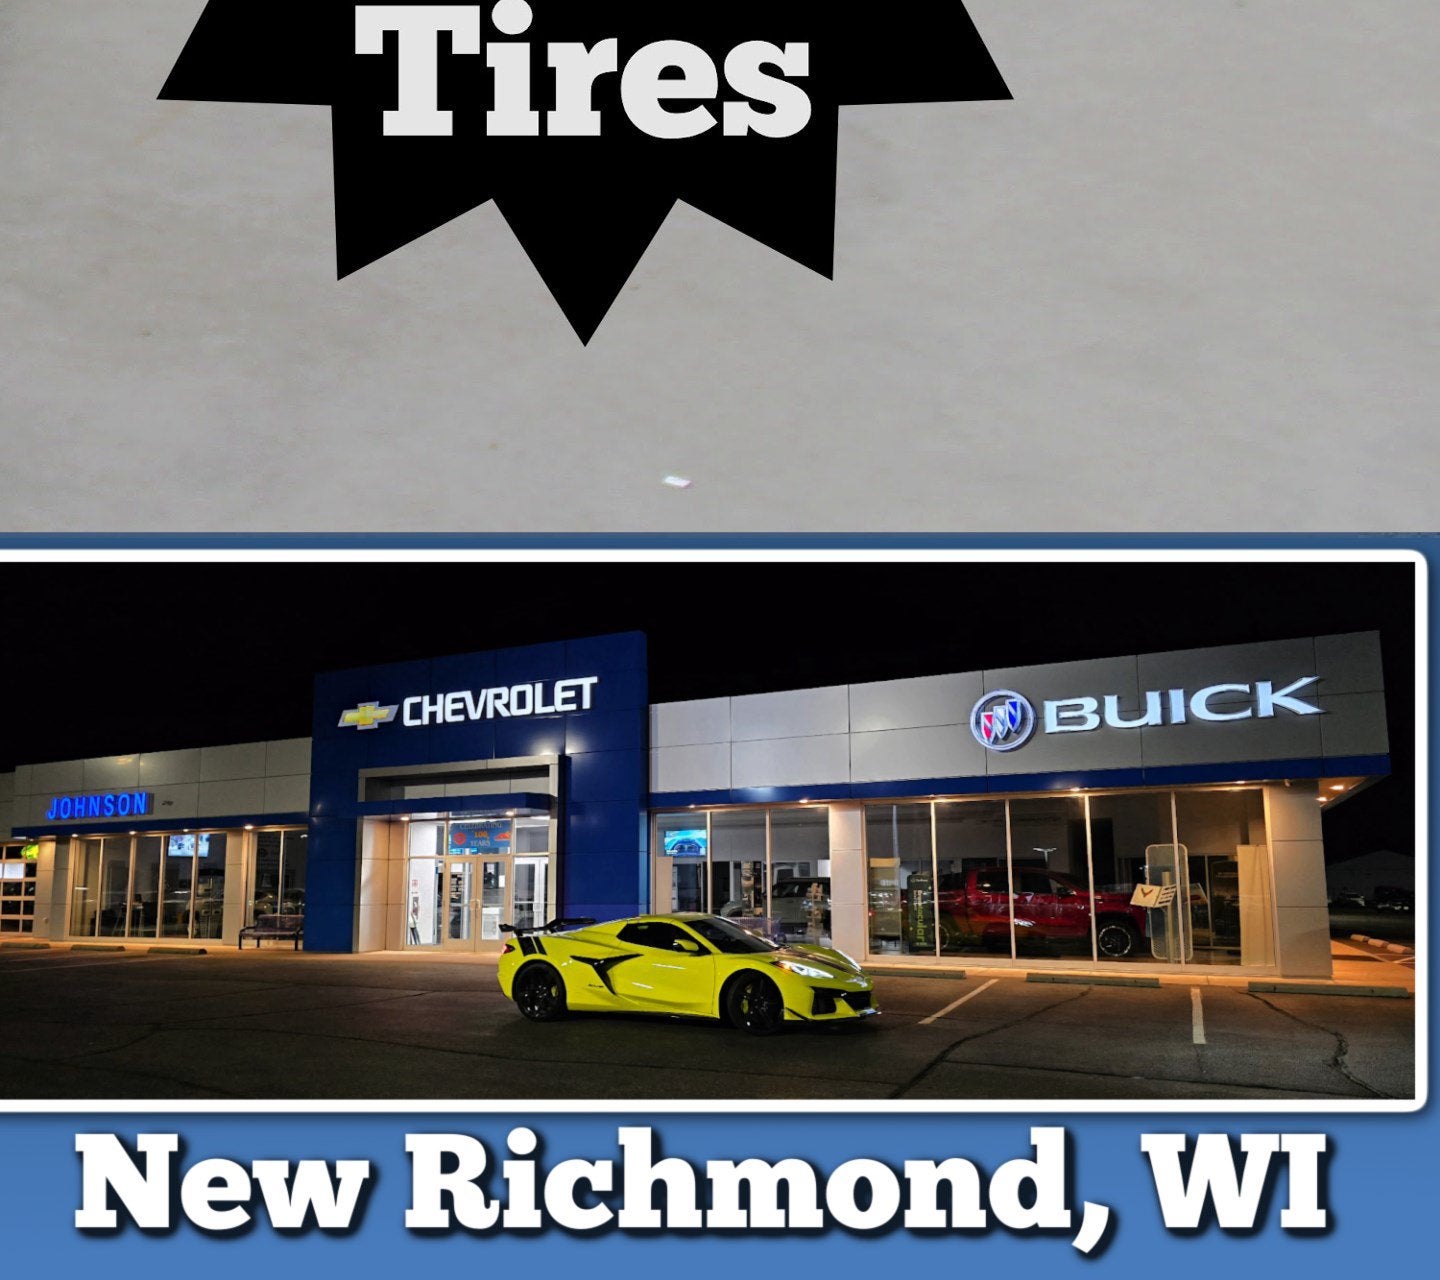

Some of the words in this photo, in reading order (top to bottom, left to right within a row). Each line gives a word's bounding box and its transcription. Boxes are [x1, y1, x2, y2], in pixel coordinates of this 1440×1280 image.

[402, 676, 599, 727] CHEVROLET
[1043, 676, 1325, 735] BUICK
[46, 791, 148, 820] JOHNSON
